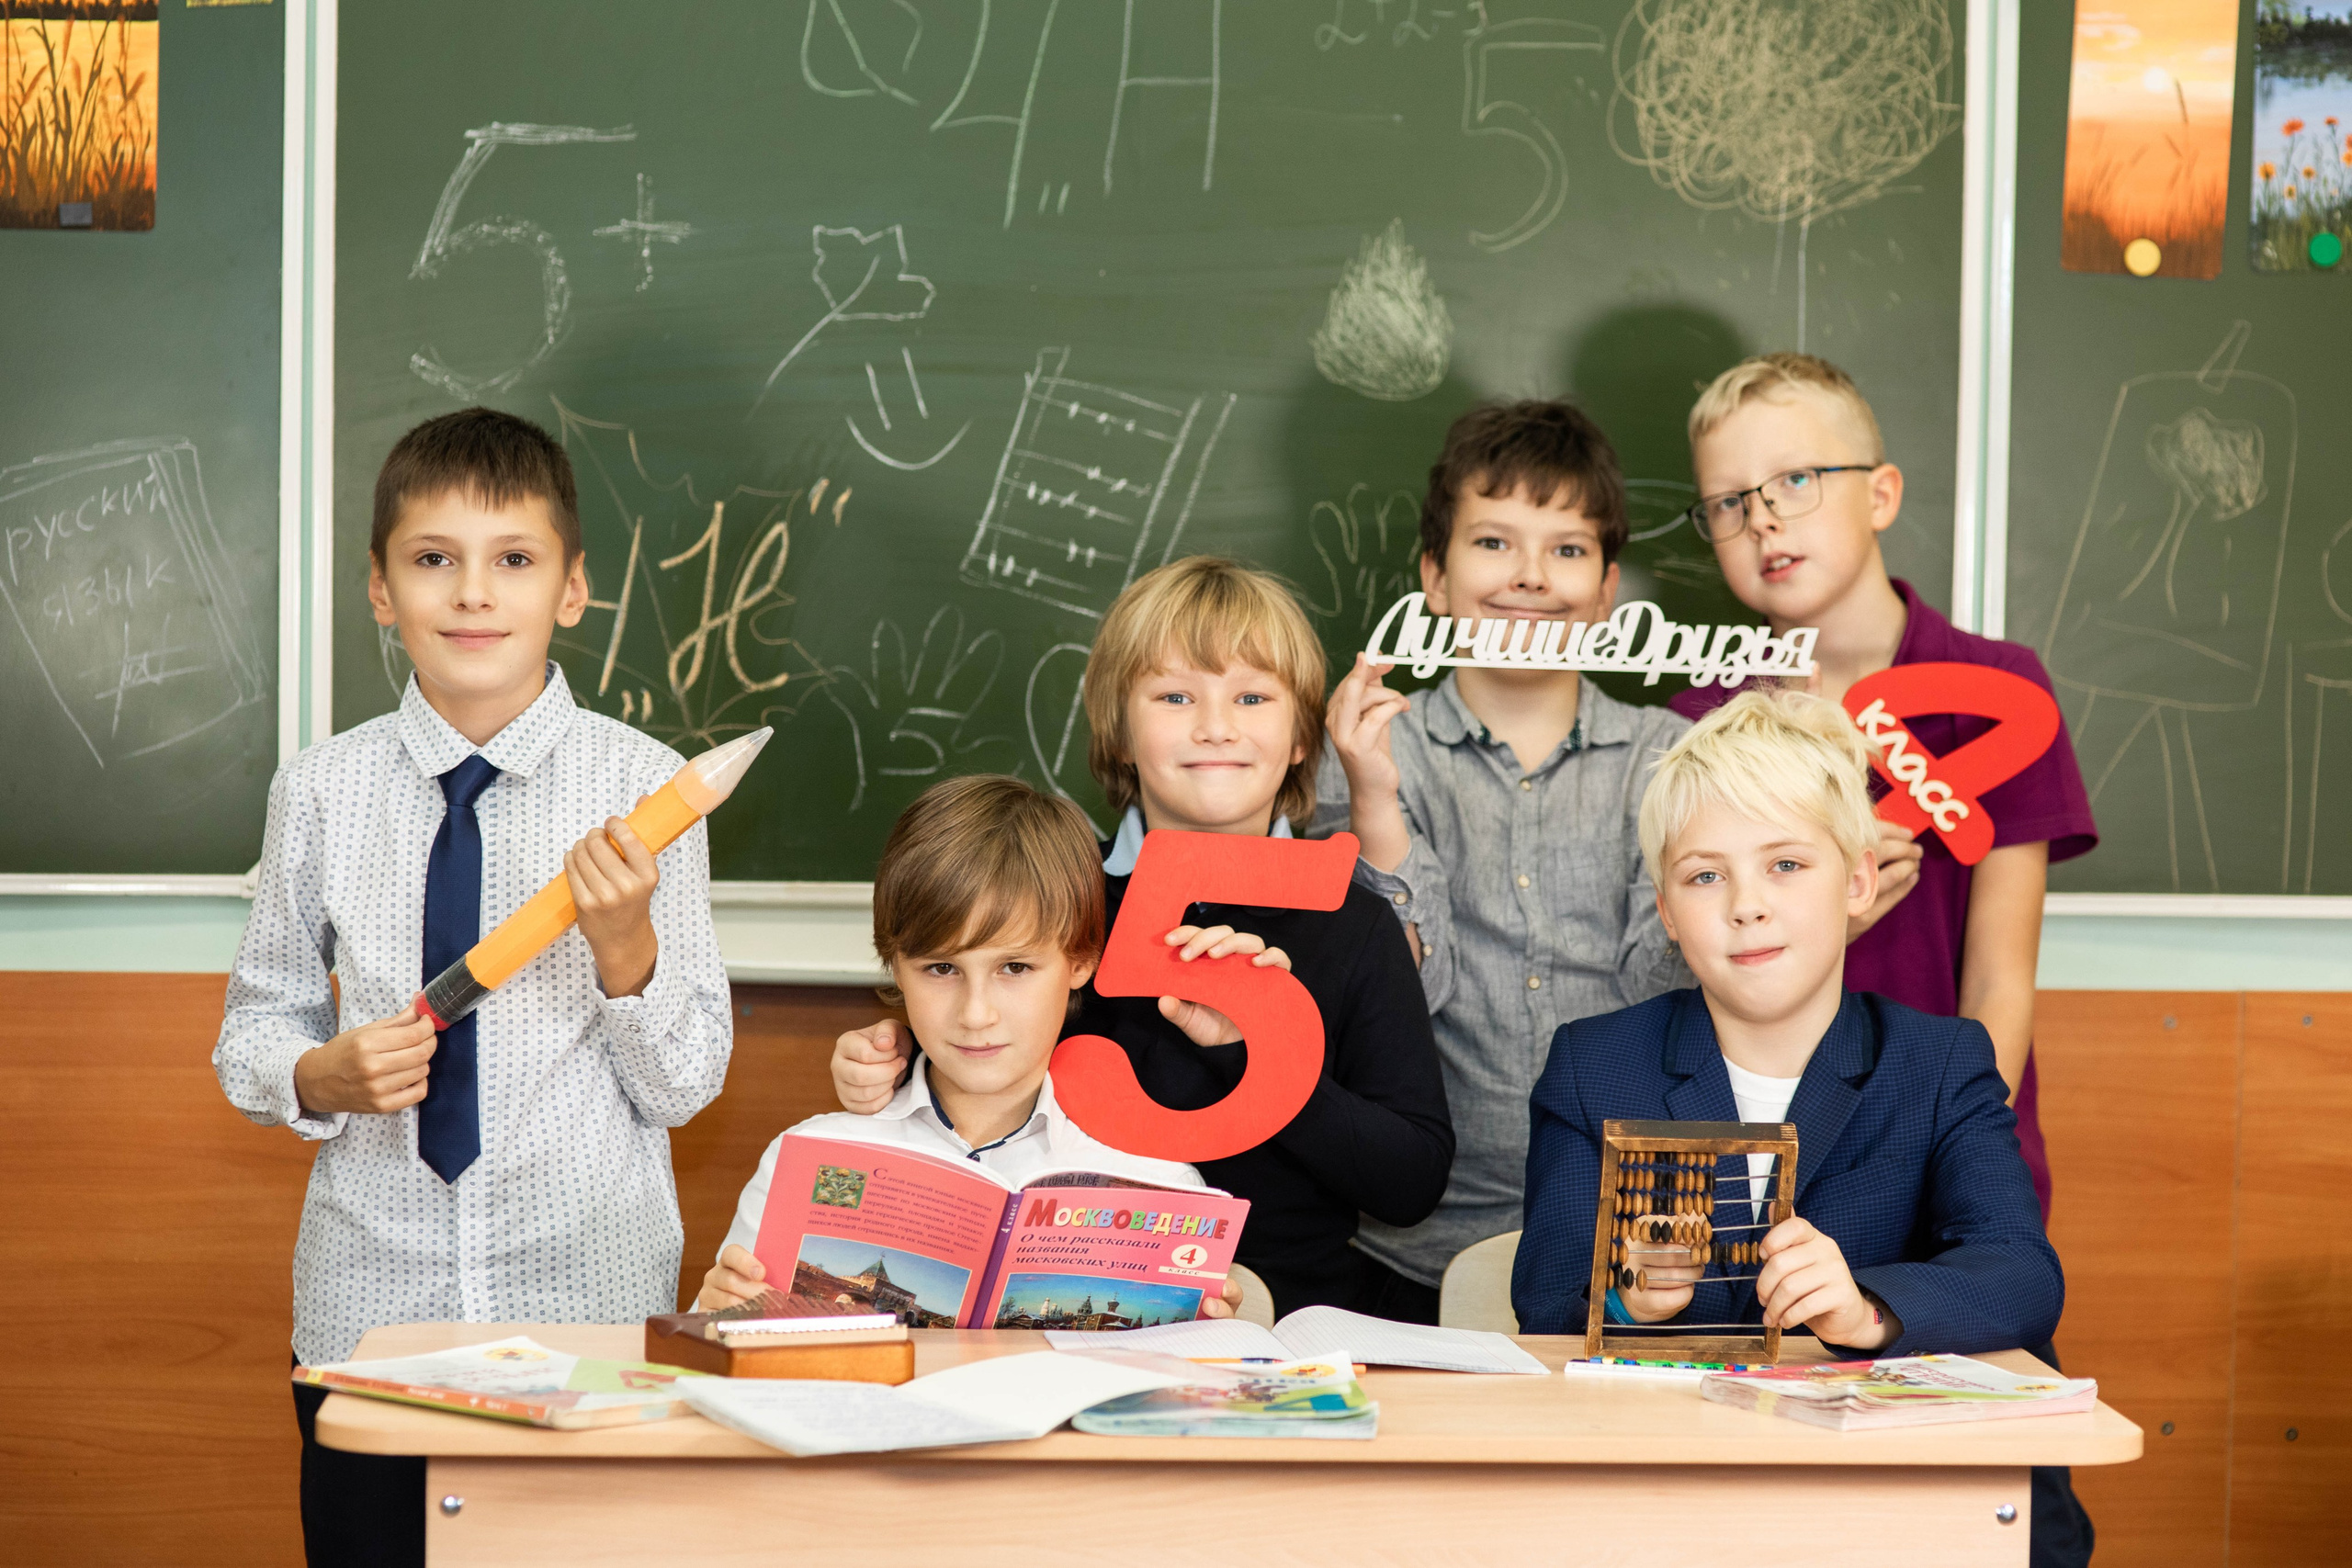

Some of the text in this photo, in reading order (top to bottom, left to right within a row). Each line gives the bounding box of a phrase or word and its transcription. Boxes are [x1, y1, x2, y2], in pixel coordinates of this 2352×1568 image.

[1051, 829, 1362, 1163] 5
[1020, 1233, 1162, 1250] О чем рассказали
[1015, 1246, 1091, 1255] названия
[1179, 1247, 1198, 1265] 4
[1012, 1255, 1149, 1272] московских улиц
[1168, 1267, 1201, 1276] класс
